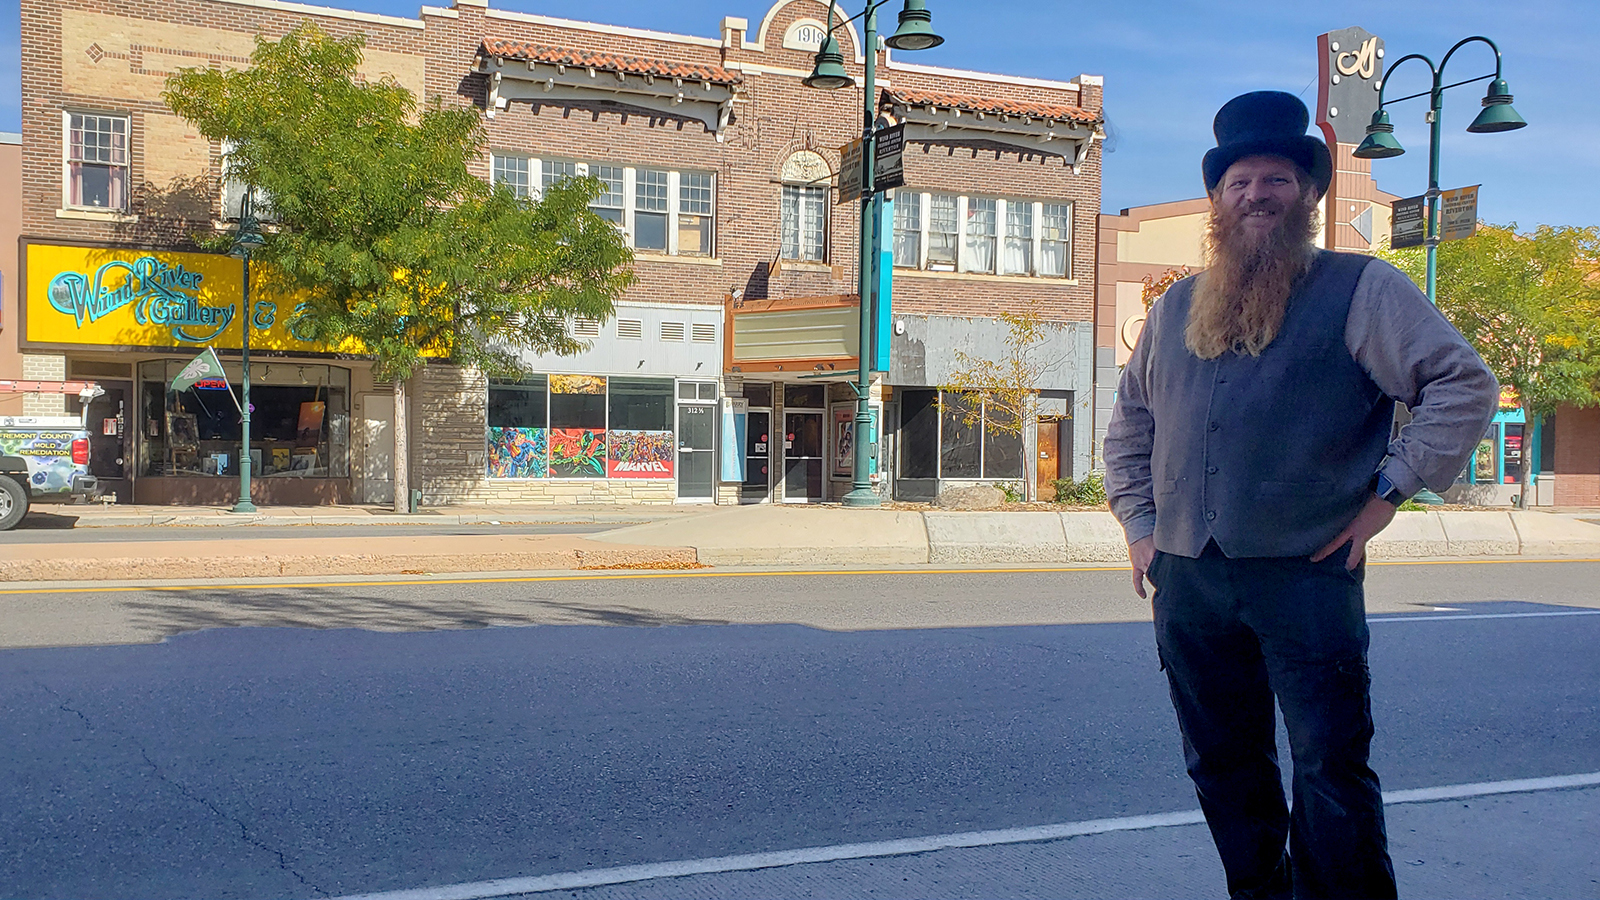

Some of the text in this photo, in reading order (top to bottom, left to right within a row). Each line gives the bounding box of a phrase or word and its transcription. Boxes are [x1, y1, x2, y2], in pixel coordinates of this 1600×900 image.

[64, 255, 204, 329] Wind River
[136, 292, 236, 343] Gallery
[253, 301, 277, 330] &
[194, 380, 226, 388] OPEN
[613, 460, 670, 472] MARVEL
